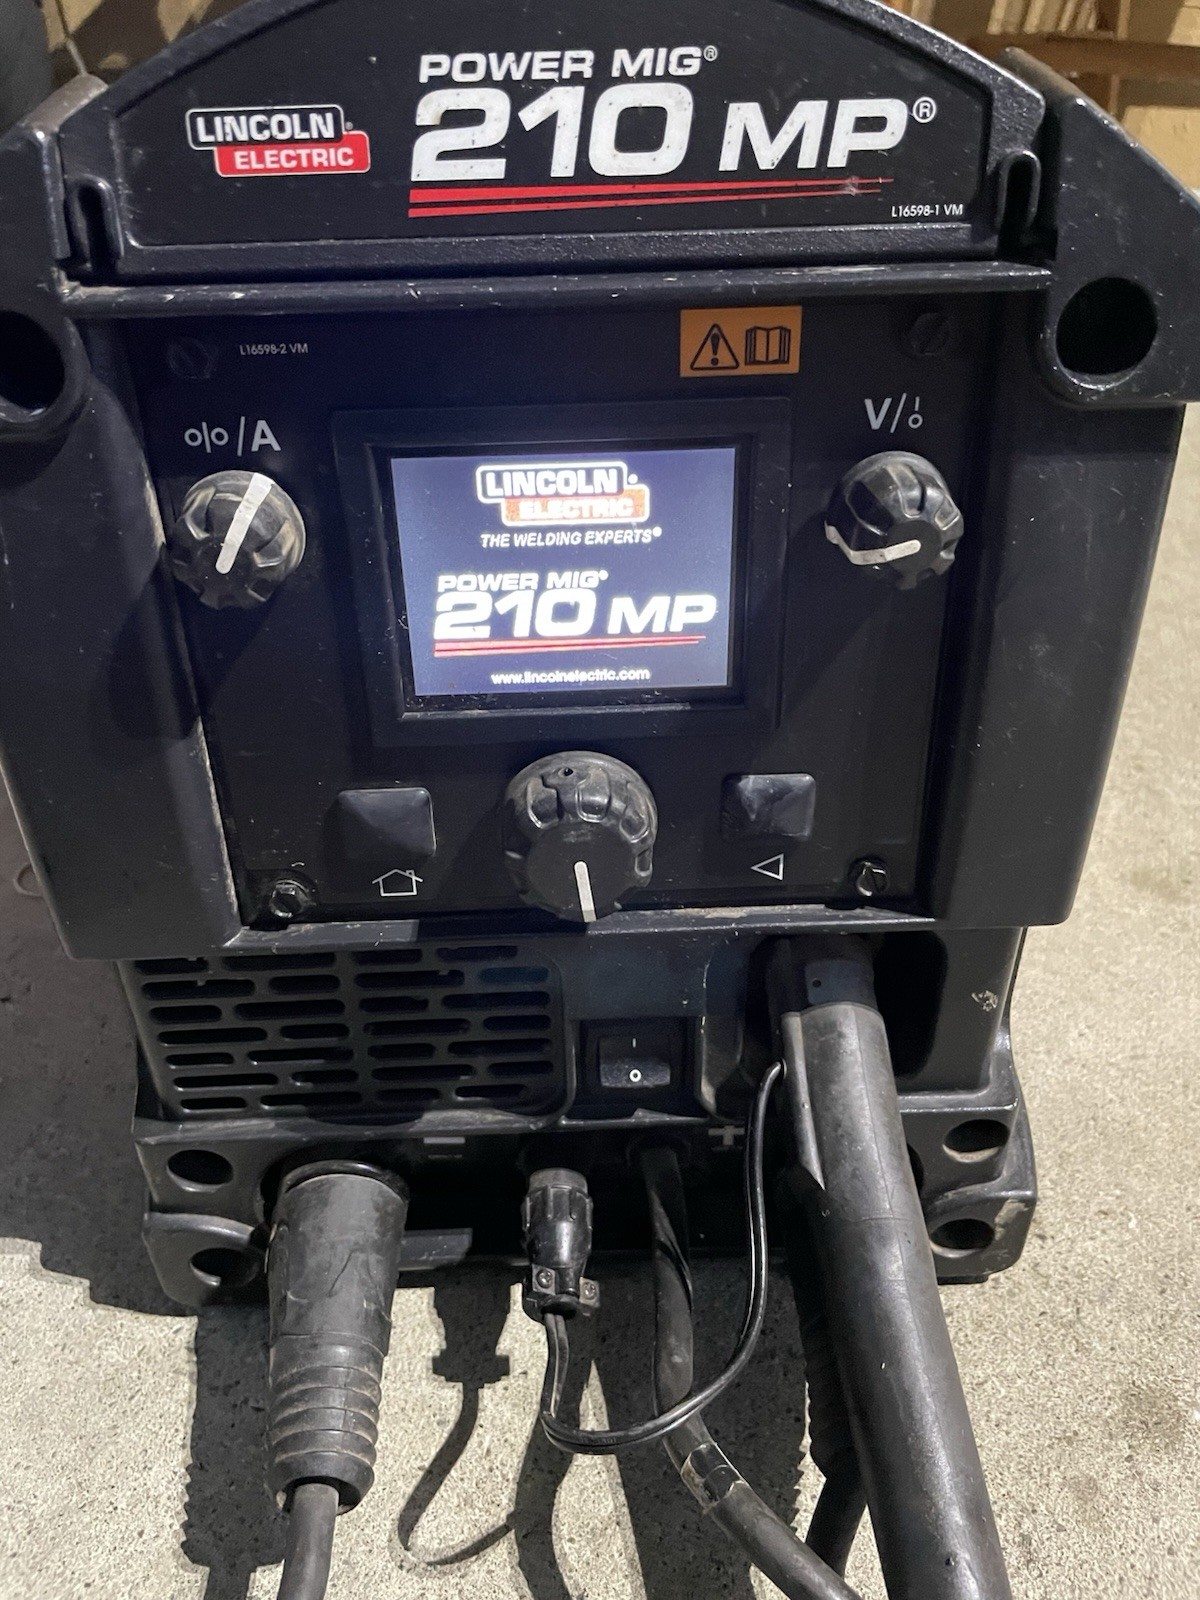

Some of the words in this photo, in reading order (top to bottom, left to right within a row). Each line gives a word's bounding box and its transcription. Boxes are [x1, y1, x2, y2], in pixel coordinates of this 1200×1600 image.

[418, 51, 595, 83] POWER
[196, 112, 336, 143] LINCOLN
[410, 82, 694, 182] 210
[233, 147, 355, 170] ELECTRIC
[891, 204, 940, 217] L16598-1
[943, 203, 963, 216] VM
[239, 343, 287, 355] L16598-2
[289, 343, 309, 353] VM
[486, 468, 618, 497] LINCOLN
[519, 499, 635, 519] ELECTRIC
[481, 533, 510, 548] THE
[513, 531, 581, 547] WELDING
[437, 573, 539, 592] POWER
[433, 588, 597, 639] 210
[607, 594, 717, 634] MP
[491, 669, 650, 685] www.lincolnelectric.com
